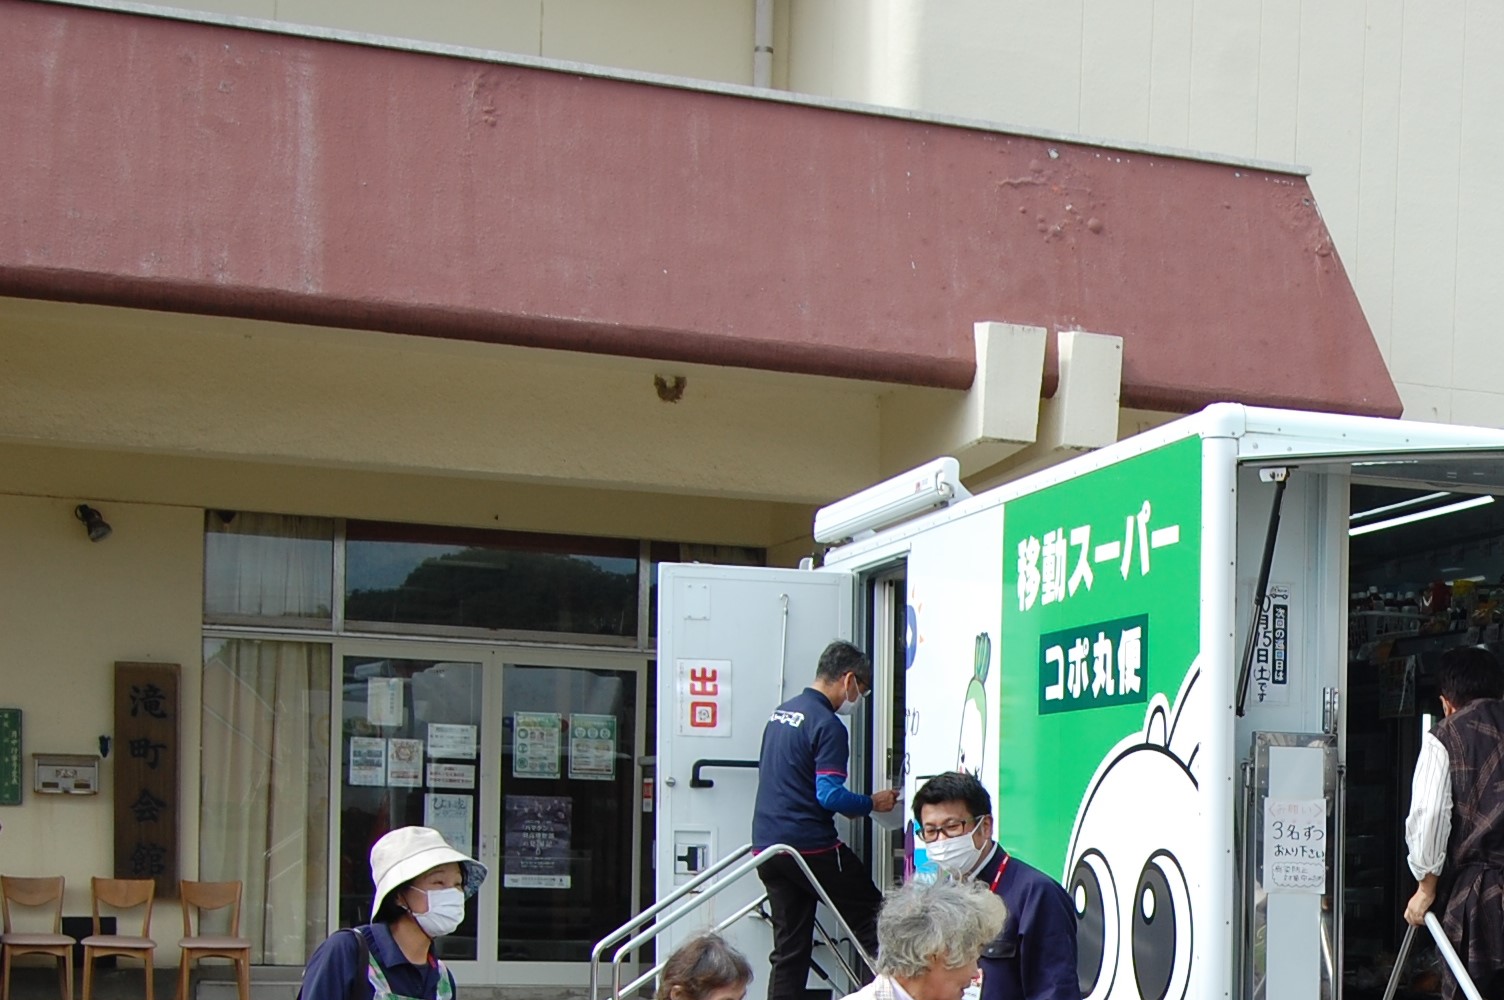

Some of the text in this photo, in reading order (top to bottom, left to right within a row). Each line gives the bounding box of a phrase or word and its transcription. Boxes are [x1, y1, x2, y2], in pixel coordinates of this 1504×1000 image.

[1017, 500, 1180, 612] 移動スーパー
[689, 667, 719, 728] 出口
[1045, 626, 1142, 701] コポ丸便
[129, 683, 168, 876] 滝町会館
[1272, 820, 1325, 841] 3名ずつ
